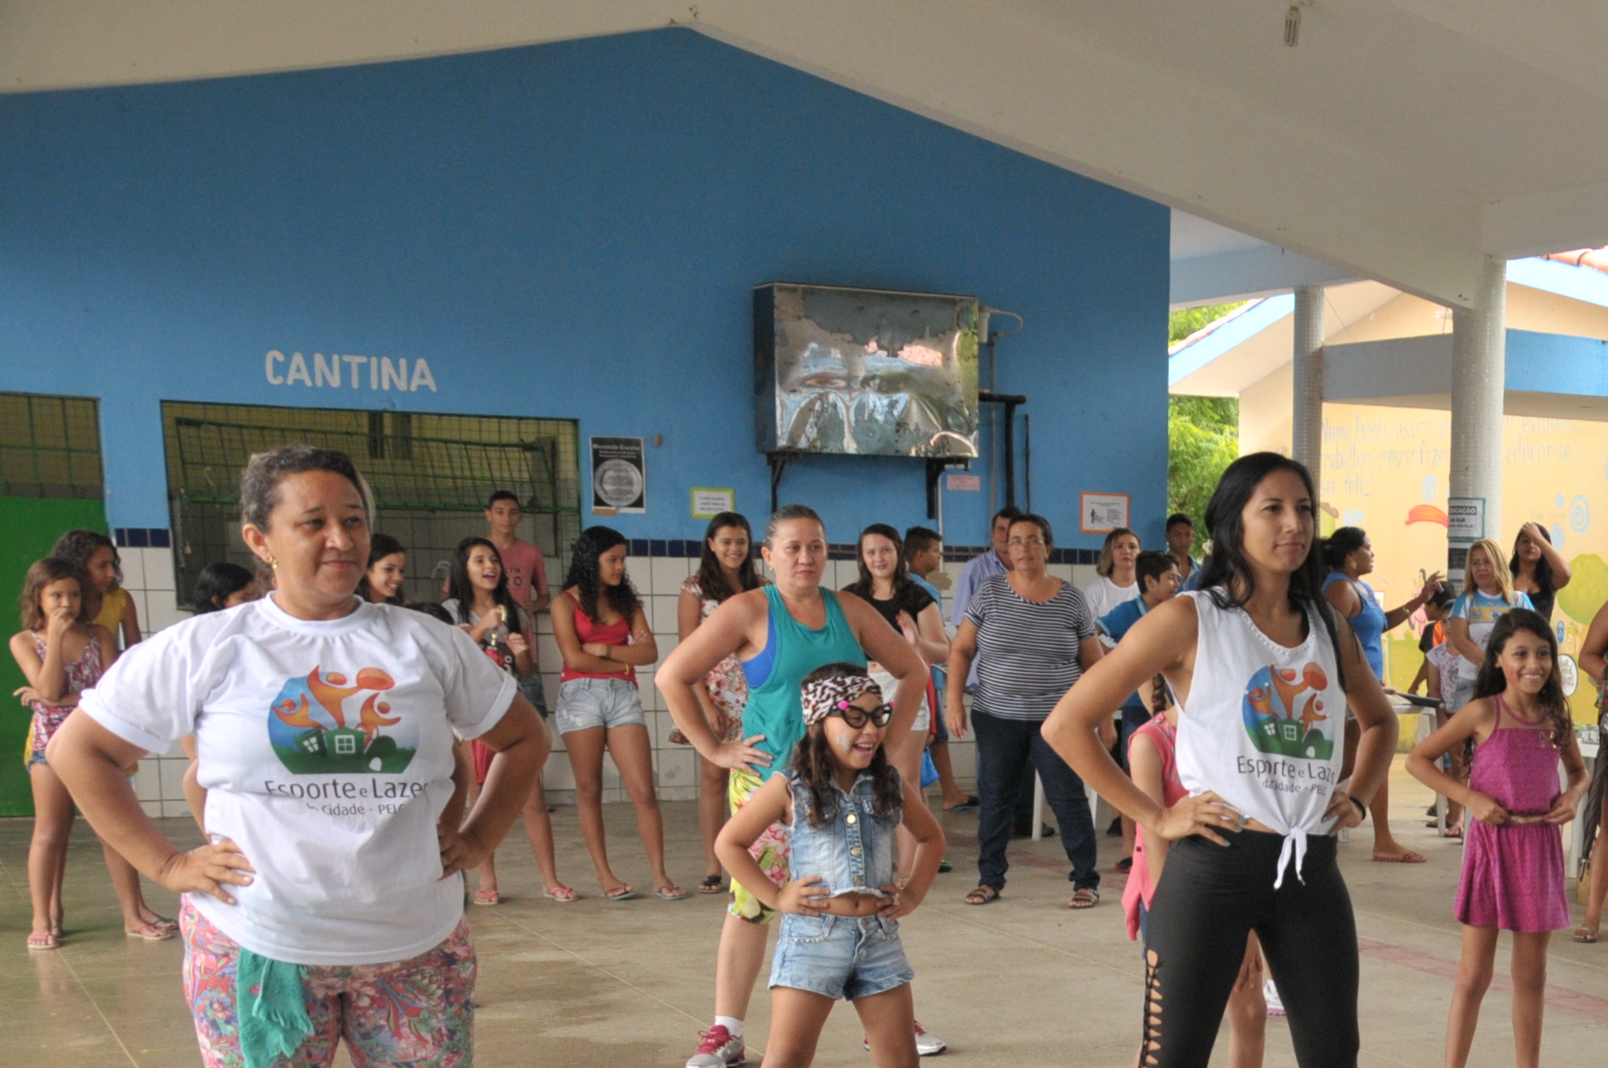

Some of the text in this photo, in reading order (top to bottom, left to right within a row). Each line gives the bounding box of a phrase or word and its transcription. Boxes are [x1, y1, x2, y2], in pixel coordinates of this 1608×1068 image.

[265, 350, 437, 392] CANTINA
[1297, 767, 1305, 778] e
[359, 787, 369, 798] e
[1275, 779, 1302, 793] idade
[321, 803, 366, 816] Cidade
